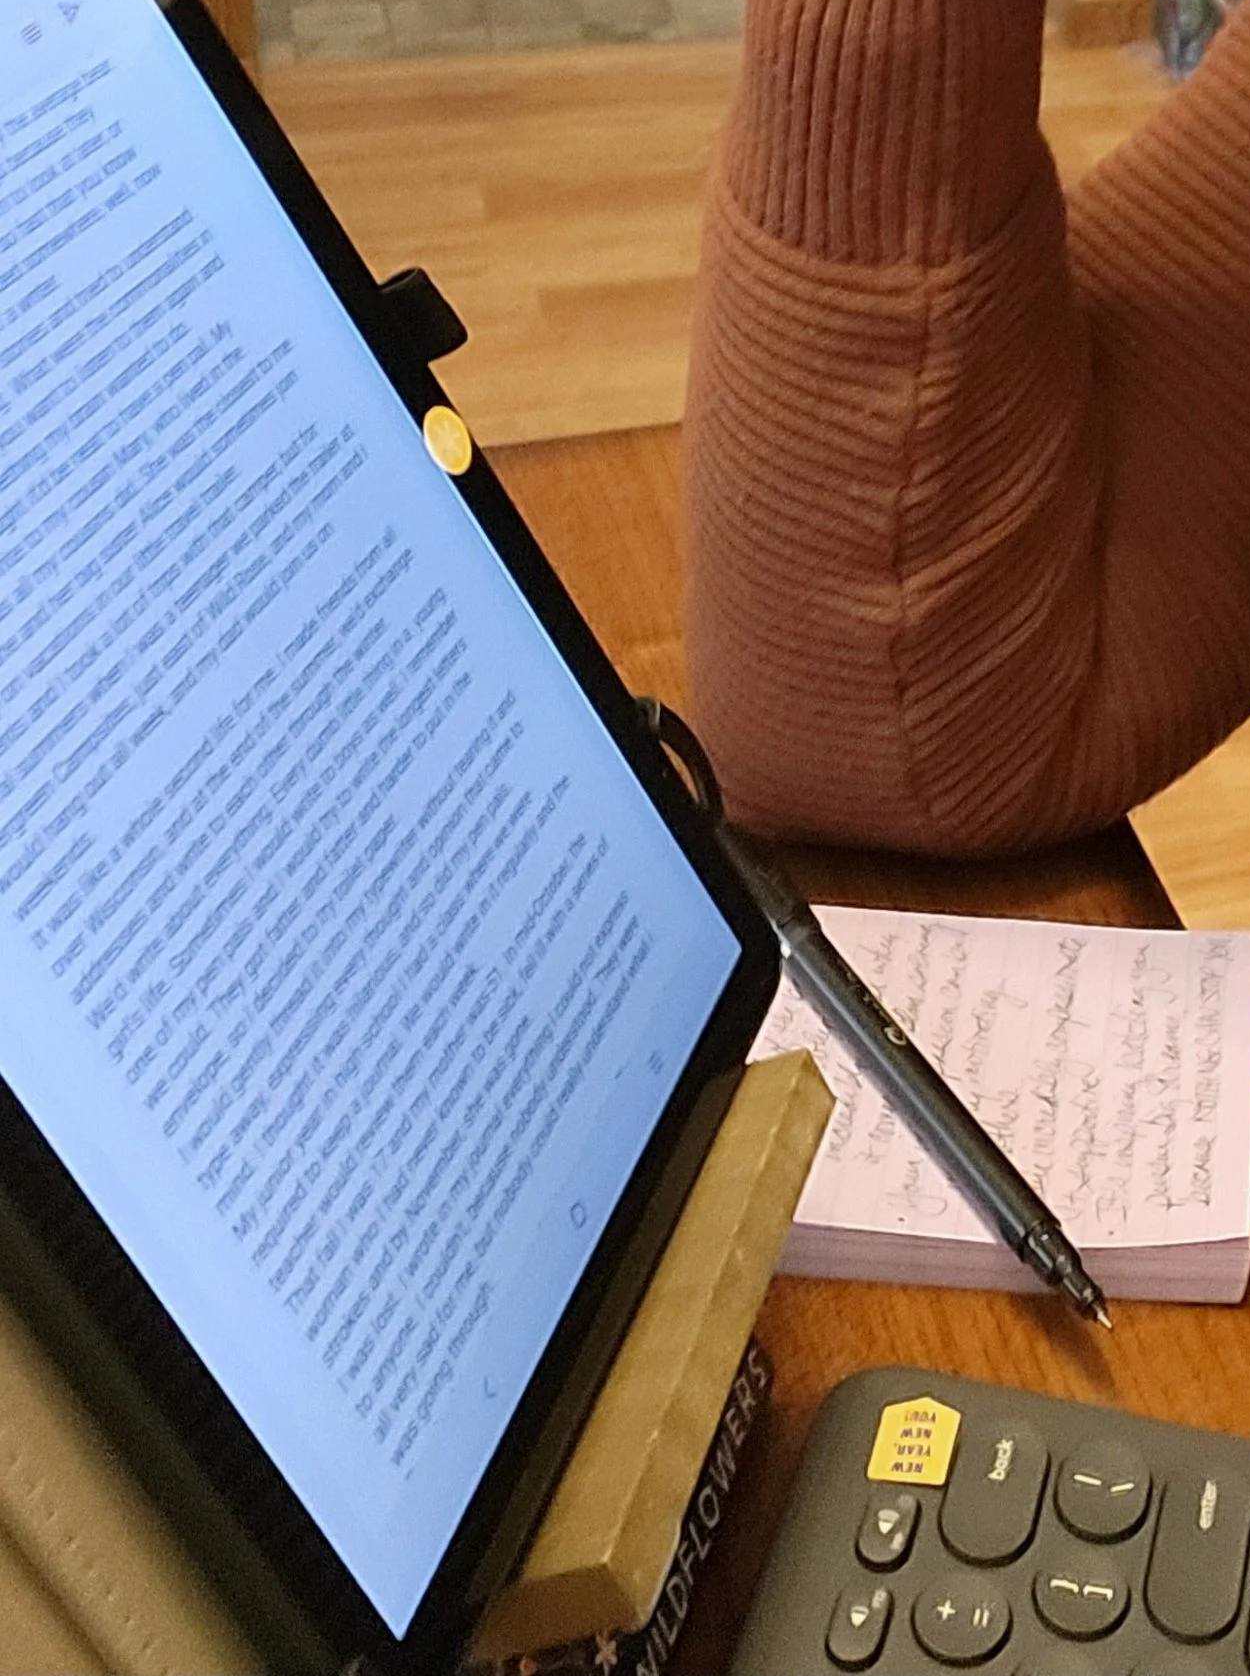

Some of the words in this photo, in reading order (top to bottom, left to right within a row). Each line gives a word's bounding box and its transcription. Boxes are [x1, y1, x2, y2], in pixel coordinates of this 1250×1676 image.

[900, 1426, 933, 1440] NEW
[988, 1439, 1015, 1481] back
[891, 1461, 924, 1474] NEW
